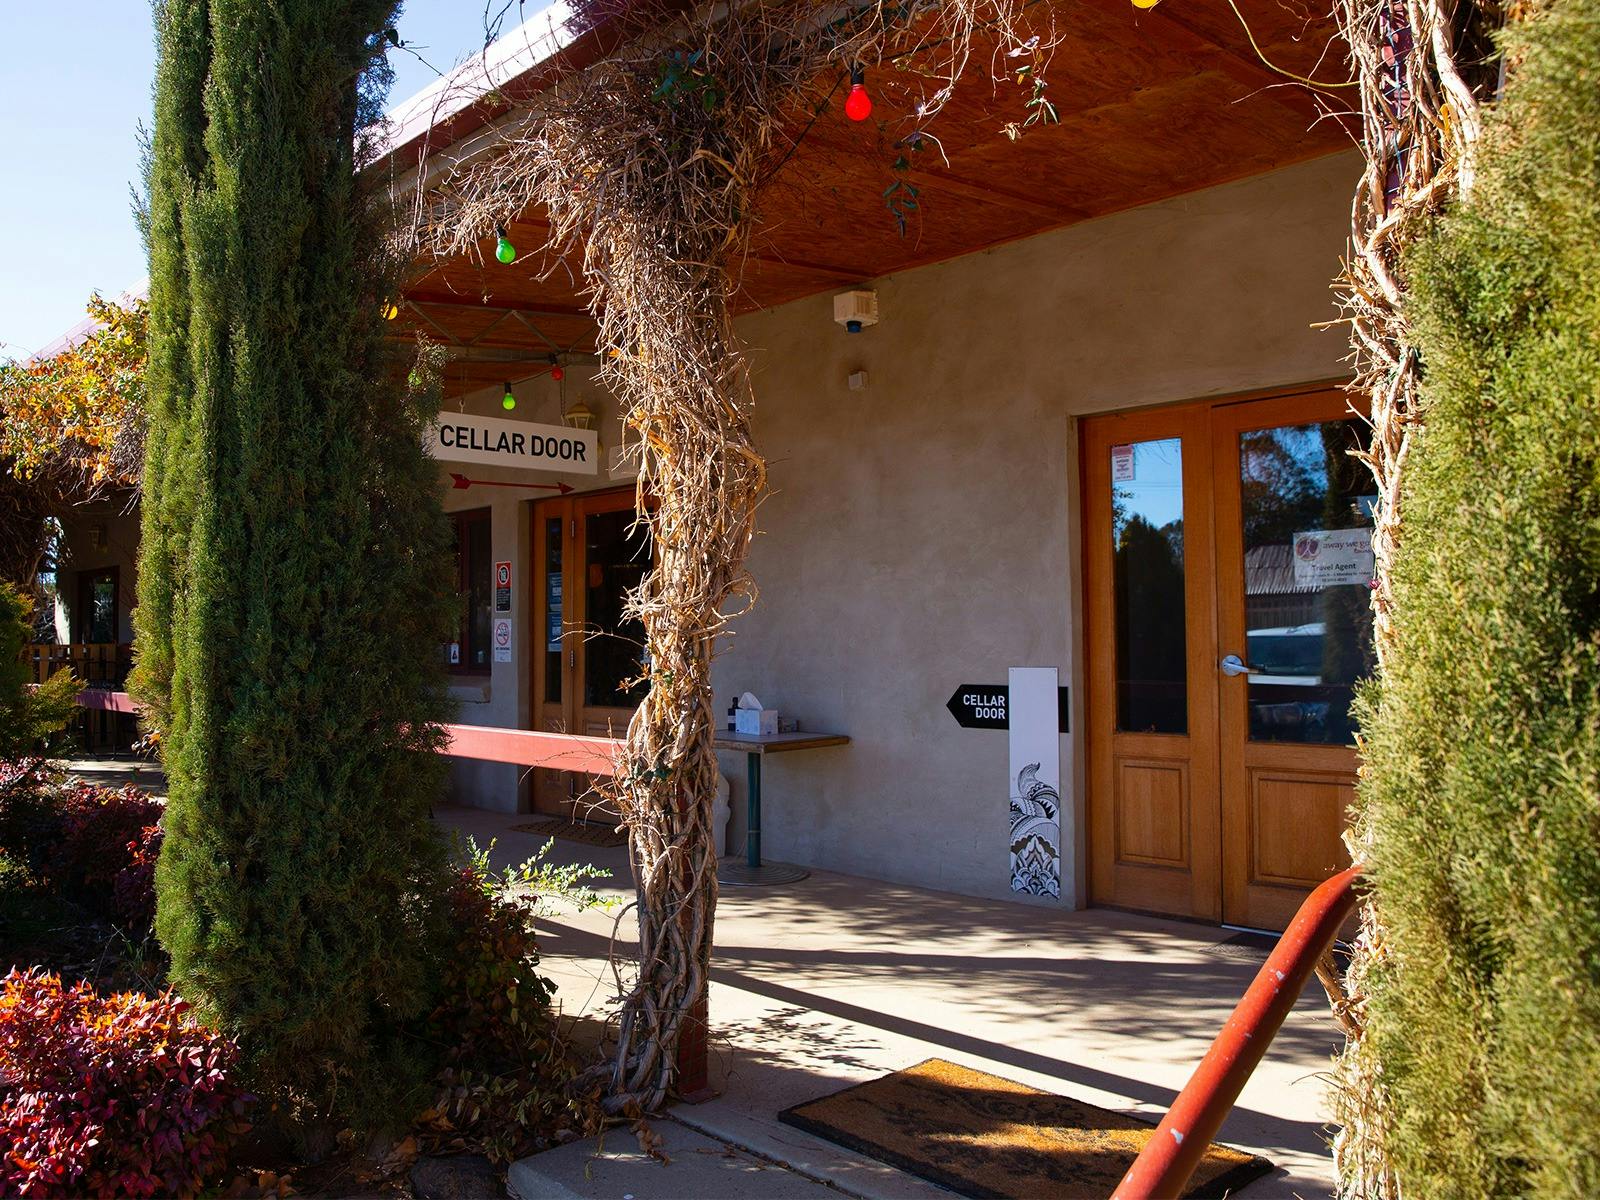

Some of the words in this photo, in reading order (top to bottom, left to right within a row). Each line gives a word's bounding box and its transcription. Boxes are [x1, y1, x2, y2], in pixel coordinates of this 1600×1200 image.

[440, 424, 526, 455] CELLAR
[531, 435, 587, 462] DOOR
[1322, 542, 1344, 551] away
[1311, 563, 1334, 571] Travel
[1334, 563, 1356, 572] Agent
[963, 694, 1006, 707] CELLAR
[975, 707, 1006, 720] DOOR
